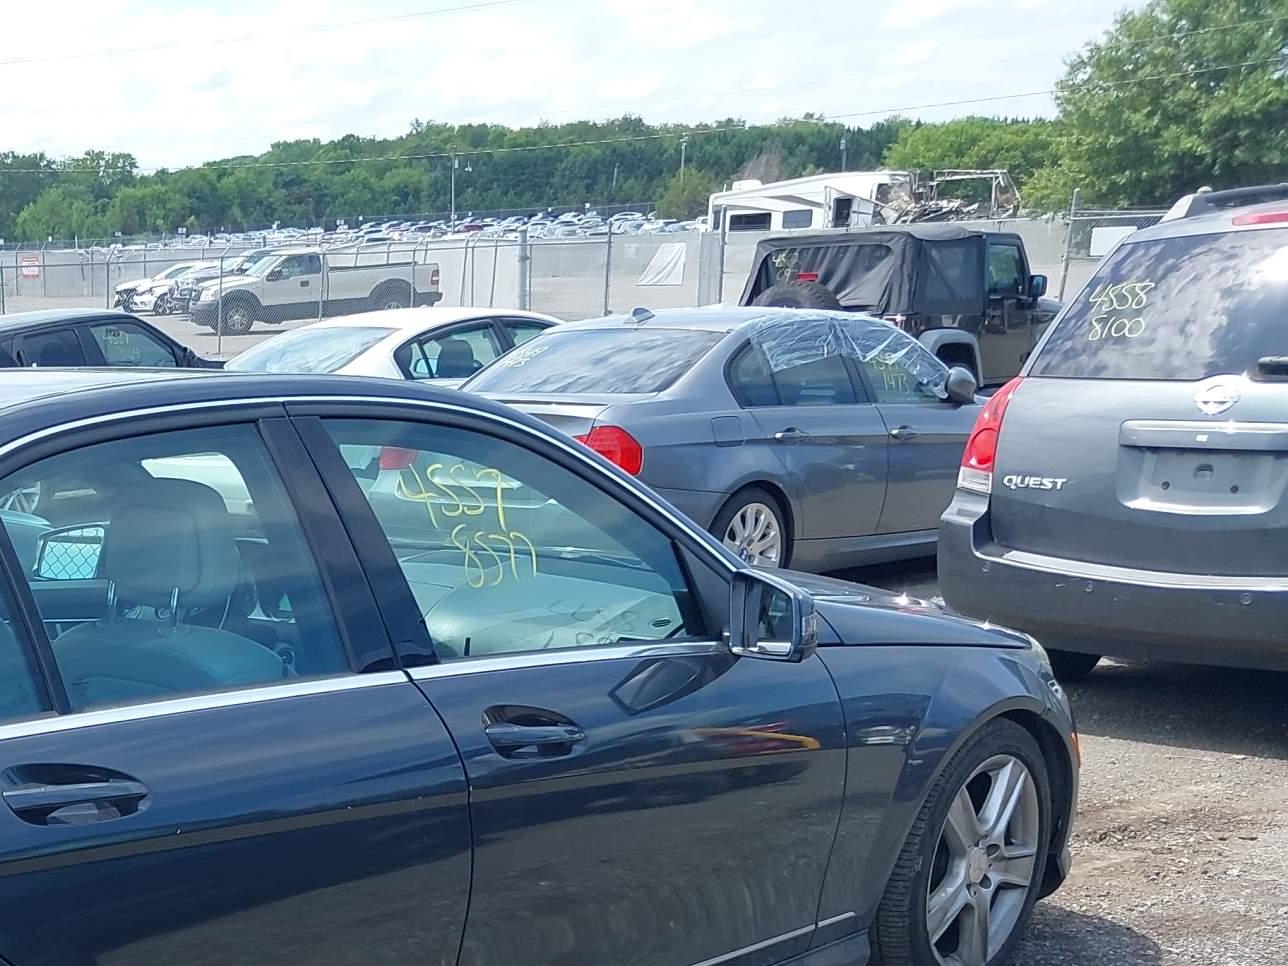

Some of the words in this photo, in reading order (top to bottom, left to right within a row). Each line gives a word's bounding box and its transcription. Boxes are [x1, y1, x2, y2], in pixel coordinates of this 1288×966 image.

[1089, 283, 1155, 312] 4558
[1088, 314, 1145, 340] 8100
[394, 463, 507, 531] 4557
[1003, 475, 1068, 490] QUEST
[451, 523, 537, 589] 8577
